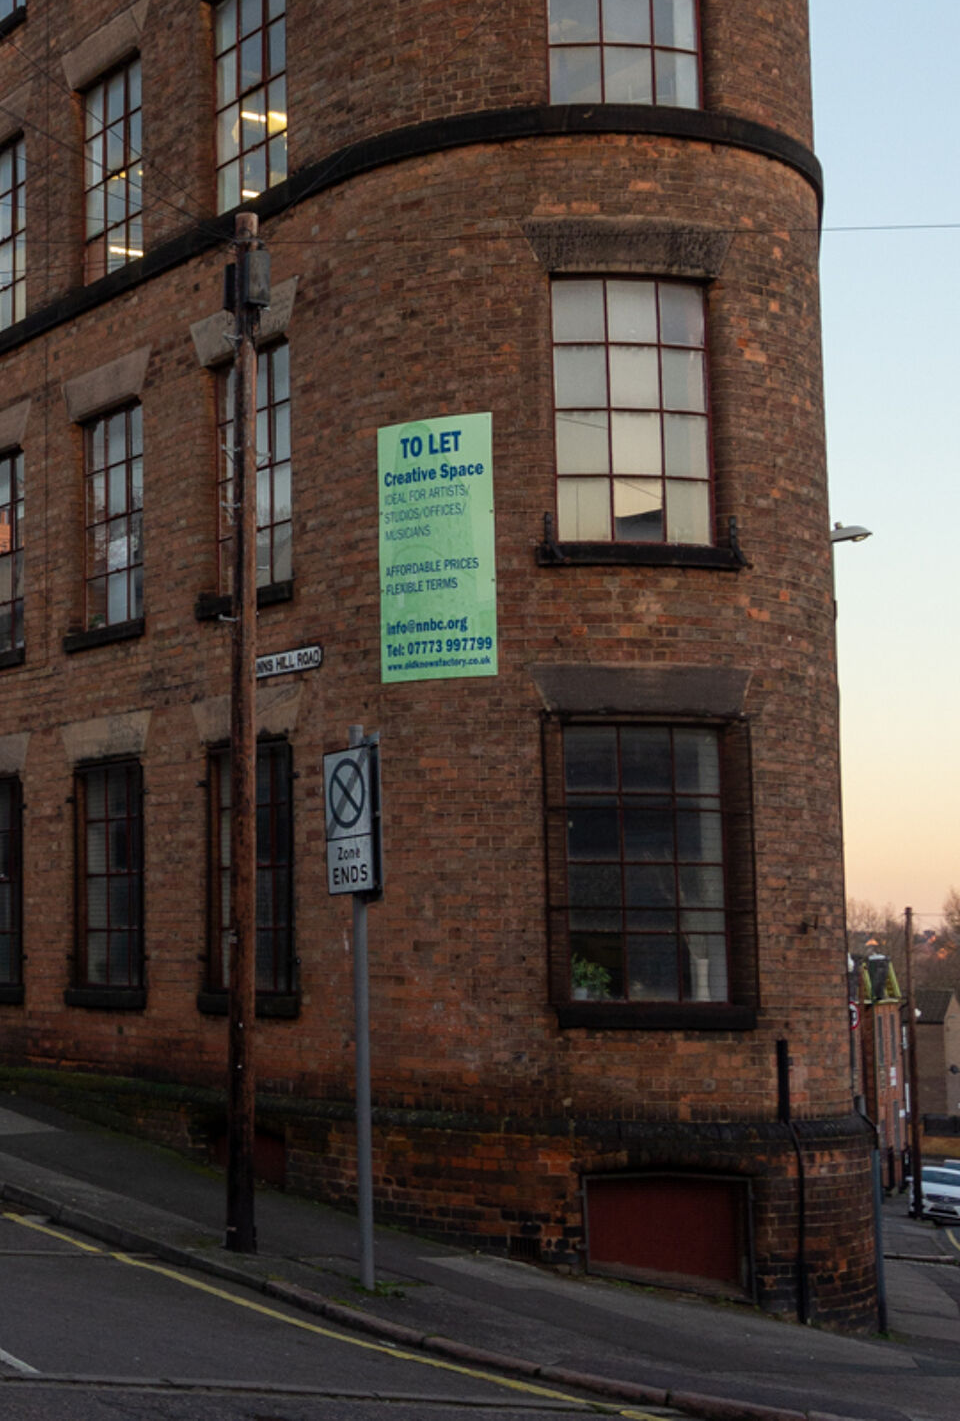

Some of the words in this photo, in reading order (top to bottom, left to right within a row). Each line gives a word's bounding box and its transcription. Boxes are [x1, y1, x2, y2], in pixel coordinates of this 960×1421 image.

[400, 436, 423, 459] TO
[428, 431, 462, 455] LET
[384, 467, 437, 487] Creative
[440, 463, 484, 481] Space
[384, 493, 407, 506] IDEAL
[409, 489, 426, 501] FOR
[385, 524, 431, 541] MUSICIANS
[385, 560, 441, 577] AFFORDABLE
[444, 557, 479, 570] PRICES
[385, 581, 424, 595] FLEXIBLE
[426, 577, 458, 591] TERMS
[387, 616, 468, 636] info@nnbc.org
[387, 644, 405, 657] Tel:
[407, 639, 443, 656] 07773
[445, 636, 492, 652] 997799
[276, 654, 294, 671] HILL
[297, 649, 319, 666] ROAD
[337, 846, 361, 860] Zone
[332, 863, 368, 885] ENDS
